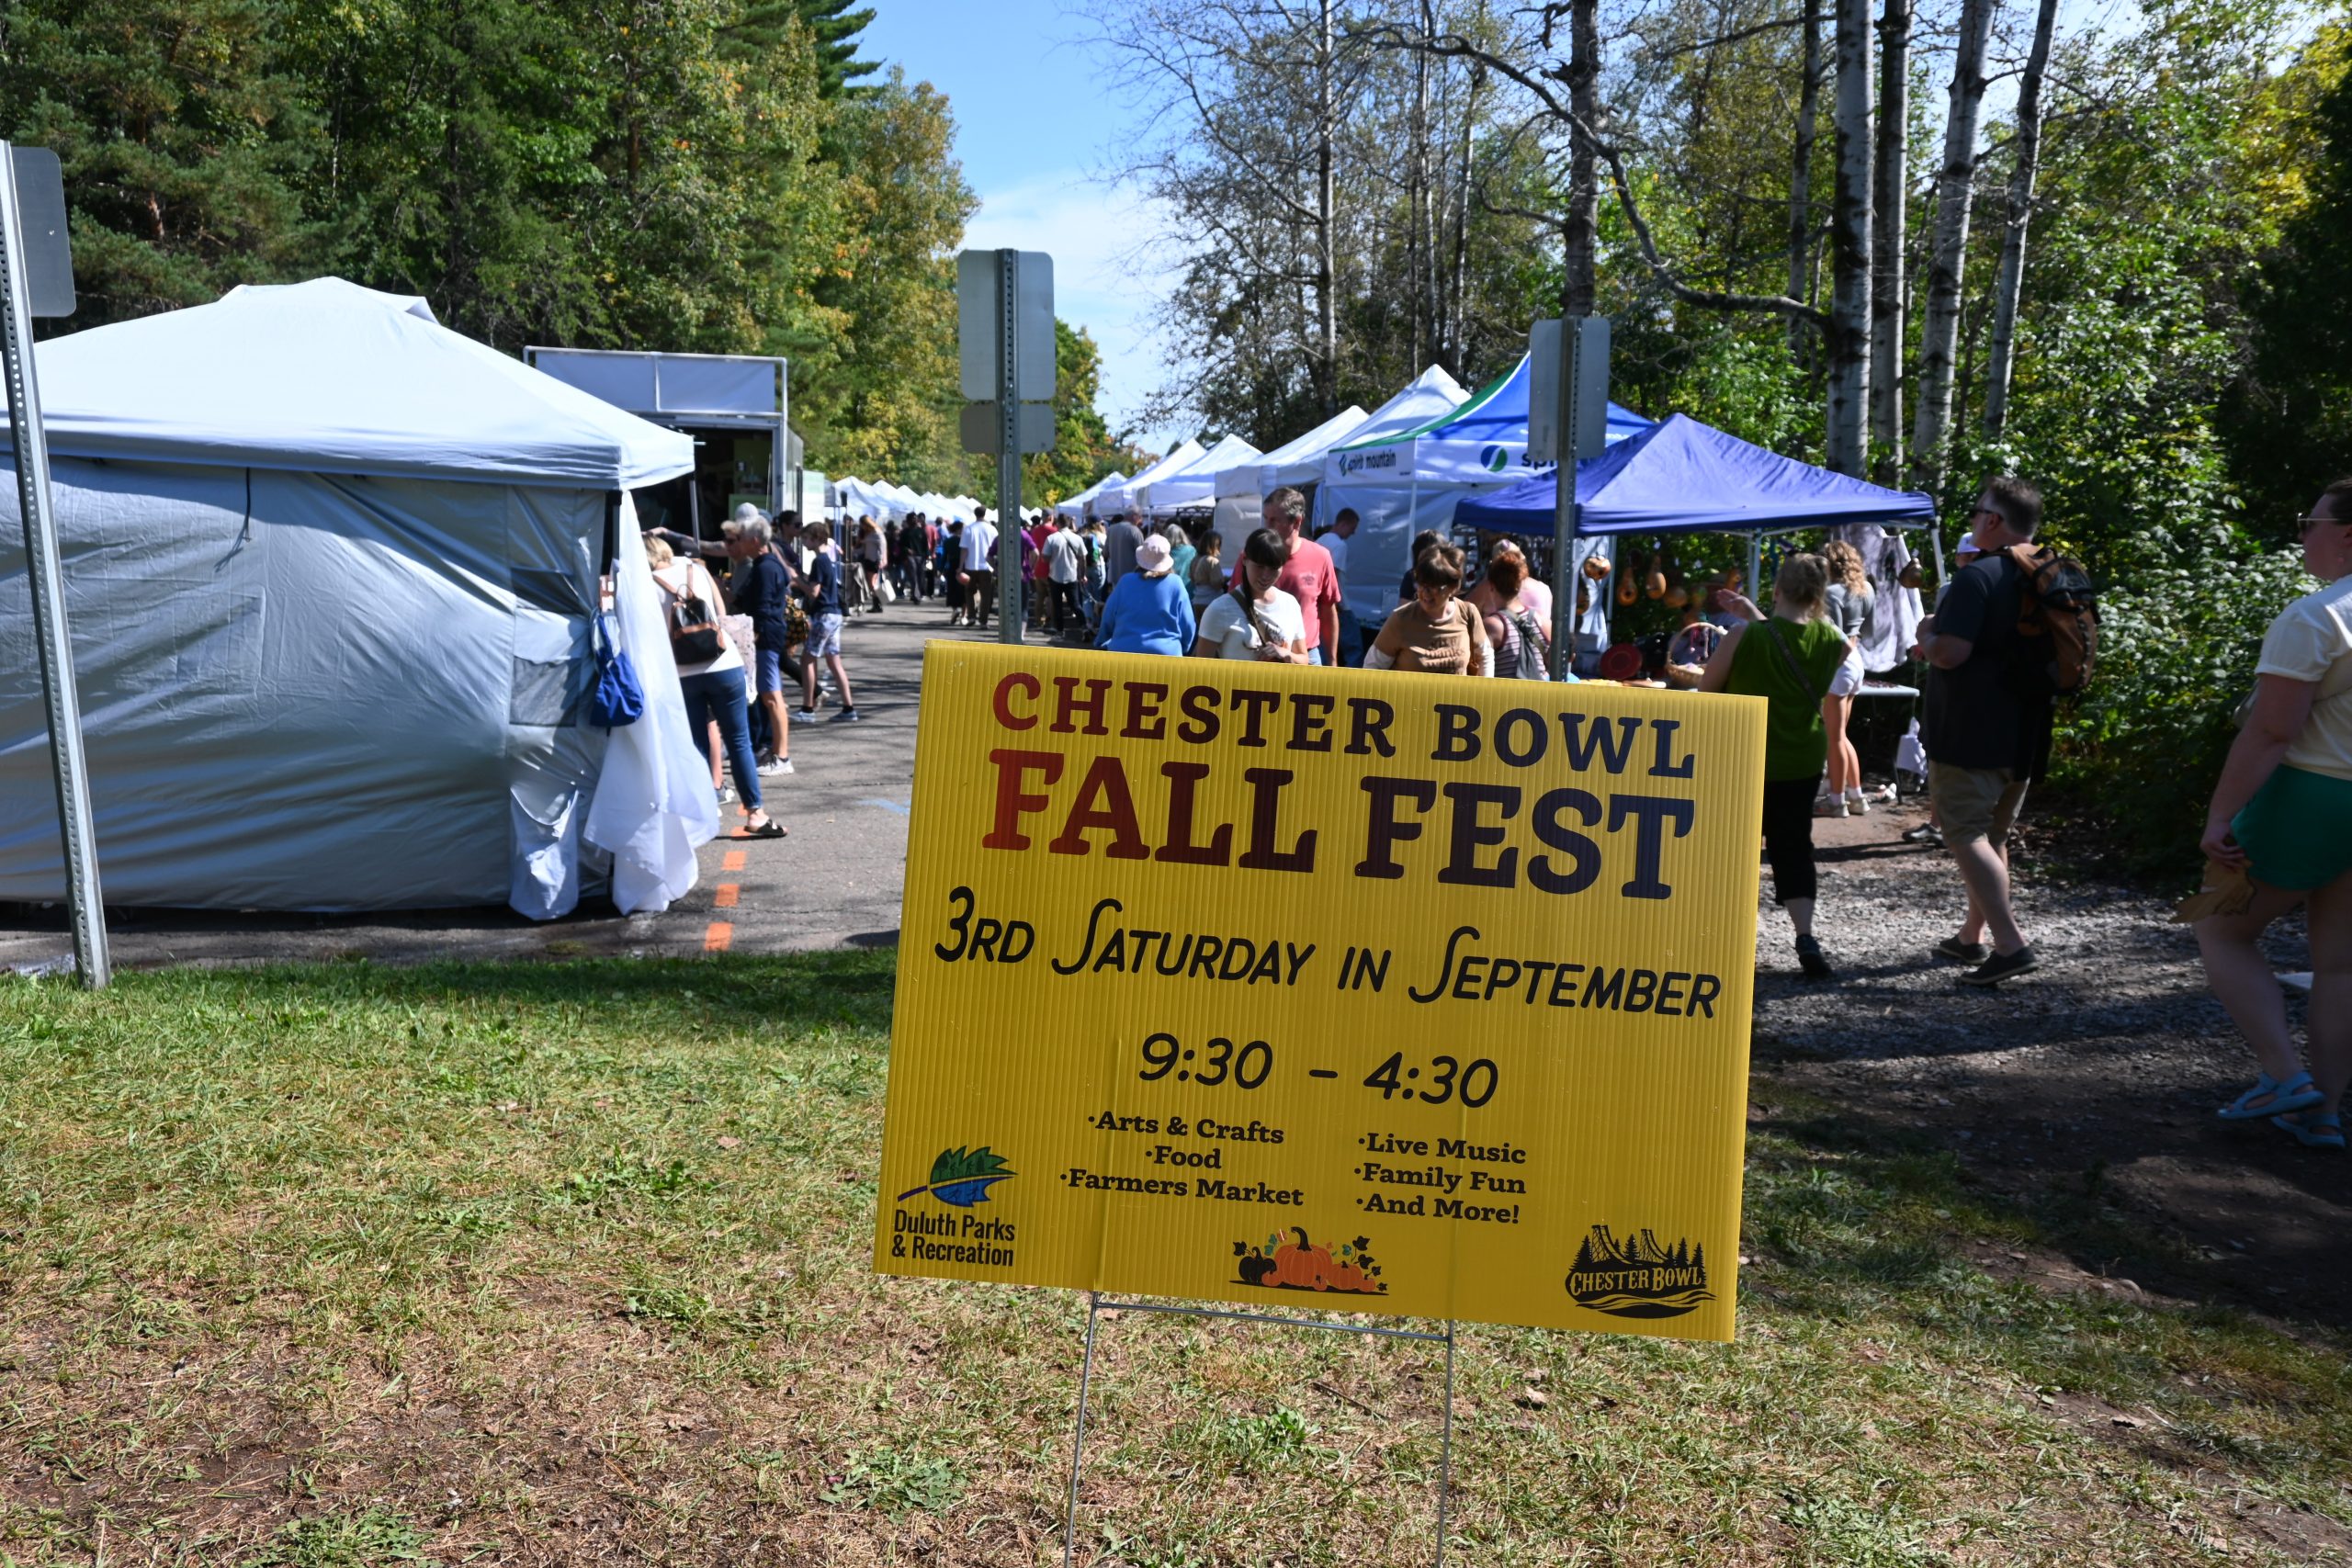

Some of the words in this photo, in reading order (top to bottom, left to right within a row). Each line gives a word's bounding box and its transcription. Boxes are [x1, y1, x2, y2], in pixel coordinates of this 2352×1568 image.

[1365, 448, 1396, 470] mountain
[991, 671, 1396, 758] CHESTER
[1430, 704, 1695, 779] BOWL
[982, 748, 1318, 874] FALL
[1353, 775, 1695, 900] FEST
[934, 886, 1035, 964] 3RD
[1051, 897, 1317, 987] SATURDAY
[1337, 946, 1392, 993] IN
[1408, 925, 1722, 1019] SEPTEMBER
[1138, 1032, 1273, 1090] 9:30
[1363, 1051, 1498, 1109] 4:30
[1166, 1116, 1188, 1136] &
[1196, 1118, 1284, 1145] Crafts
[1435, 1137, 1527, 1165] Music
[1195, 1178, 1305, 1206] Market
[1469, 1170, 1527, 1194] Fun
[894, 1209, 956, 1237] Duluth
[961, 1214, 1015, 1242] Parks
[1432, 1198, 1520, 1224] More!
[891, 1234, 907, 1258] &
[911, 1235, 1014, 1267] Recreation
[1569, 1269, 1649, 1297] CHESTER
[1651, 1266, 1702, 1292] BOWL
